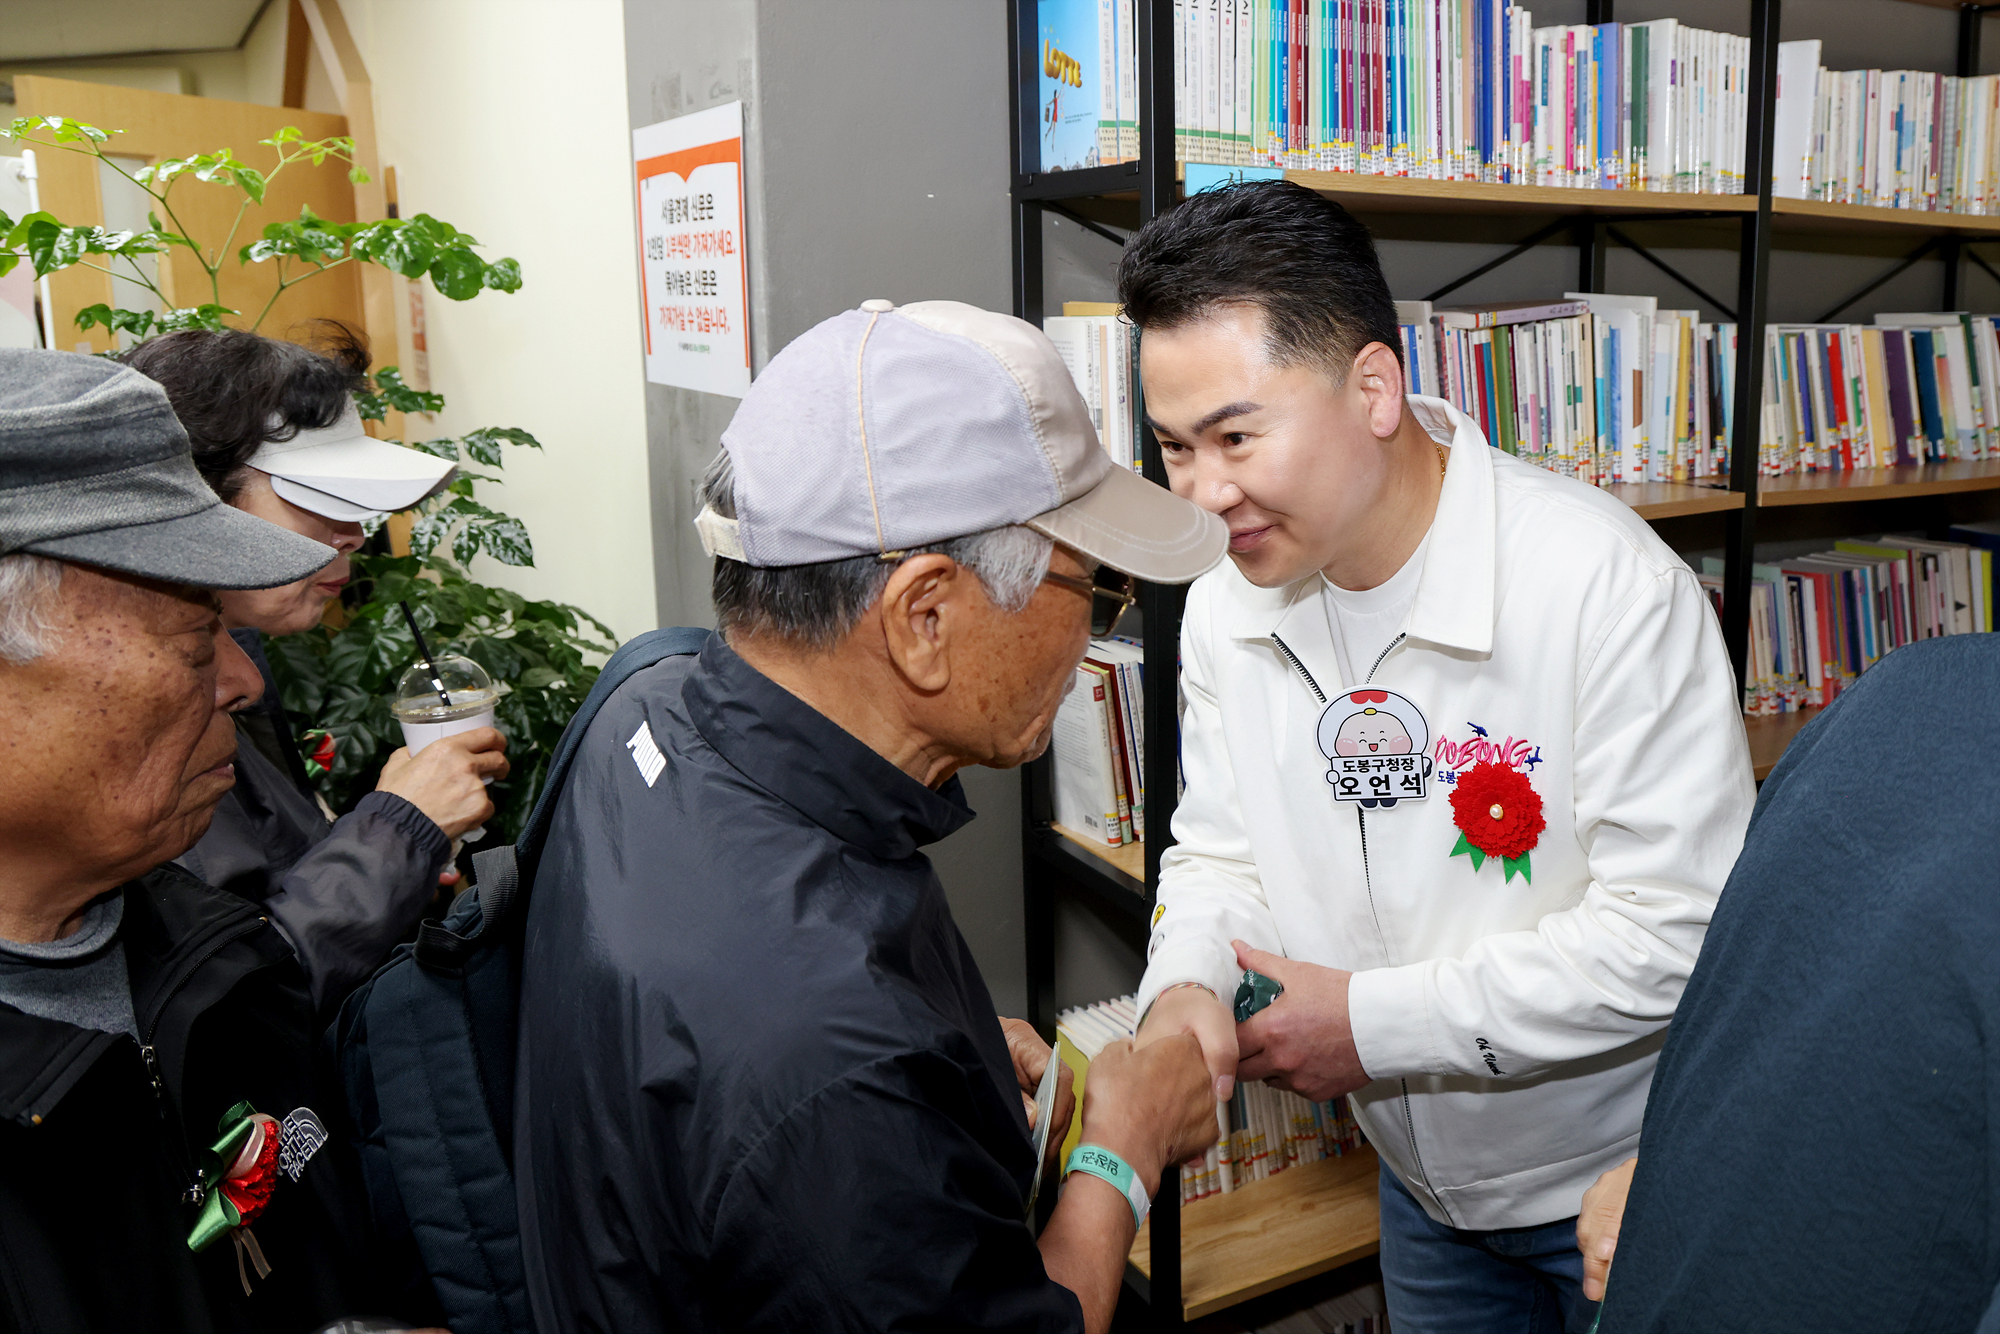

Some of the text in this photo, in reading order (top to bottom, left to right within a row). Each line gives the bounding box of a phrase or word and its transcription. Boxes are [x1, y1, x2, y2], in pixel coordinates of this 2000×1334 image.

[661, 193, 713, 224] 서울경제 신문은
[647, 229, 736, 260] 1인당 1부씩만 가져가세요.
[665, 269, 717, 296] 묶어놓은 신문은
[659, 305, 730, 335] 가져가실 수 없습니다.
[1342, 757, 1415, 773] 도봉구청장
[1434, 734, 1533, 770] DOBONG
[1437, 771, 1462, 785] 도봉
[275, 1129, 306, 1177] ORTH
[287, 1141, 314, 1183] FACE
[1081, 1151, 1119, 1176] 입장권
